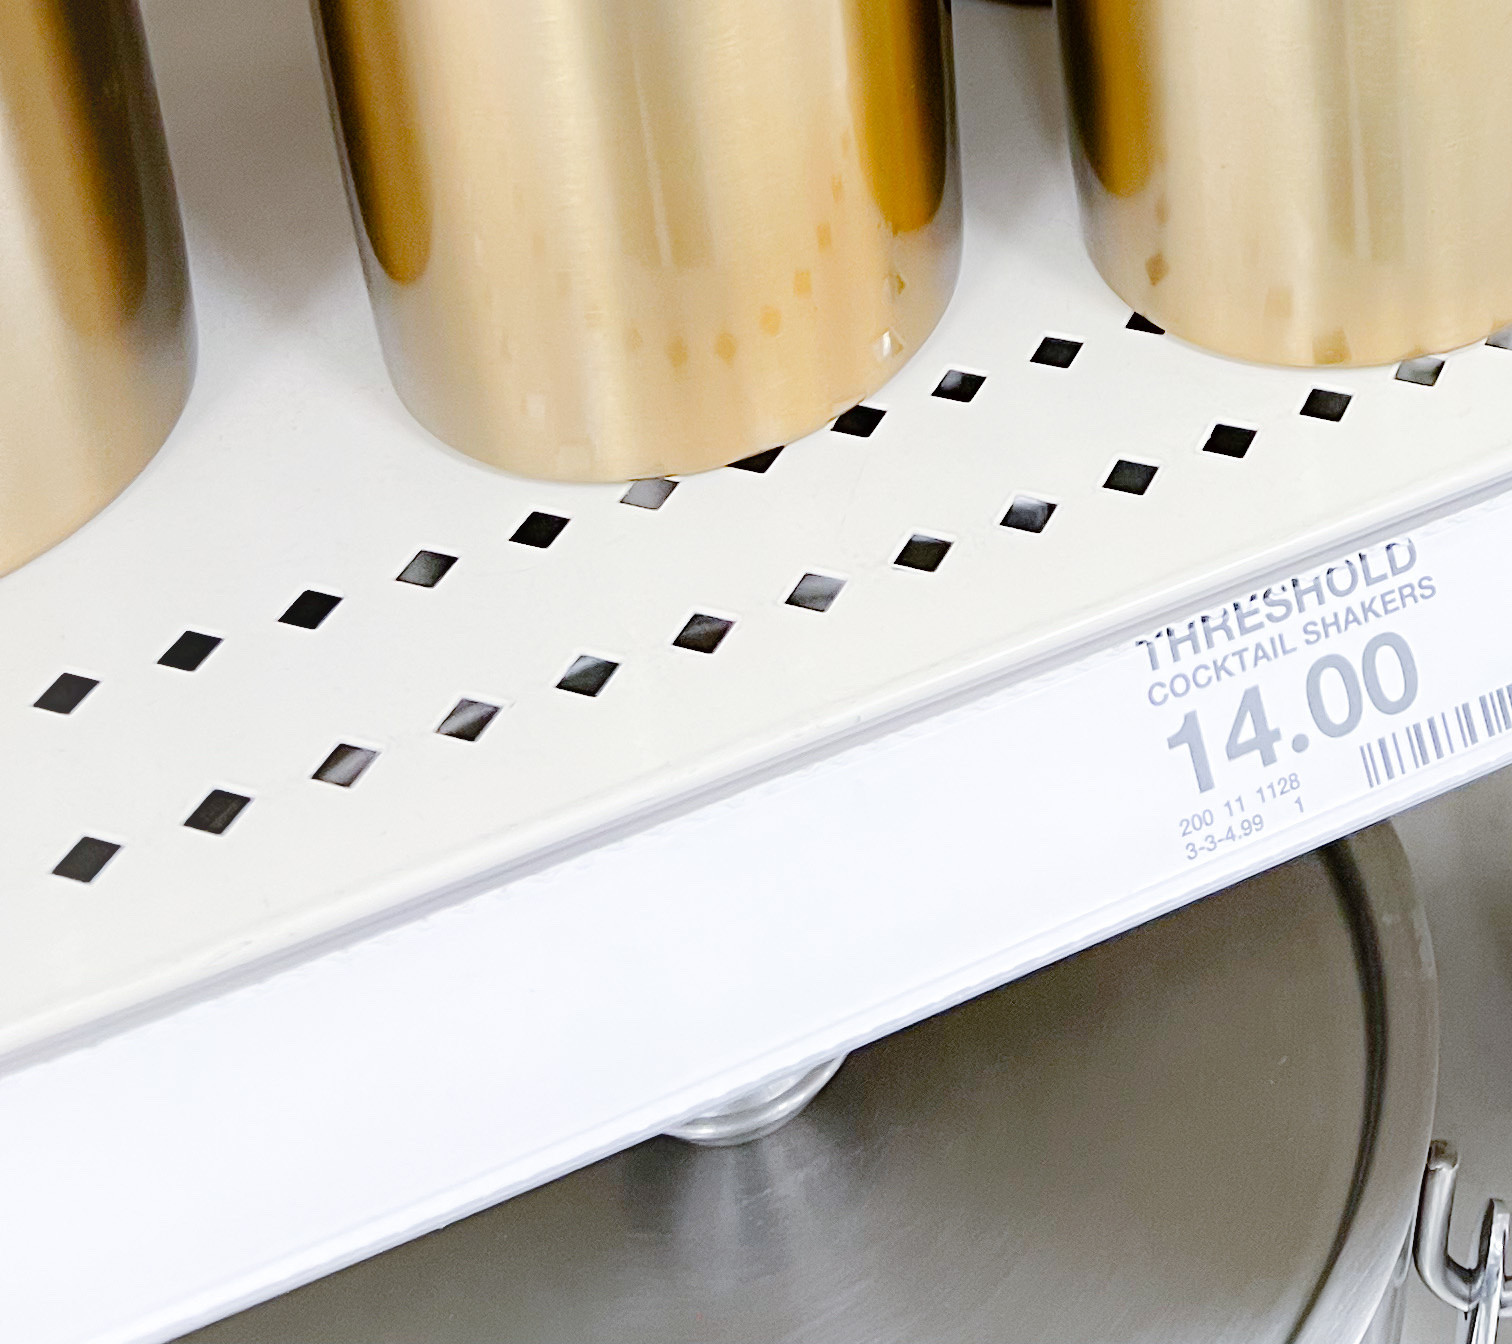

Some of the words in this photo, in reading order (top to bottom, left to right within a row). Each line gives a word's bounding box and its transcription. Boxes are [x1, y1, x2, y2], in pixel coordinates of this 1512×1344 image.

[1136, 538, 1418, 671] THRESHOLD
[1147, 633, 1298, 707] COCKTAIL
[1303, 575, 1438, 647] SHAKERS
[1167, 632, 1419, 795] 14.00
[1179, 808, 1216, 838] 200
[1223, 795, 1245, 817] 11
[1256, 772, 1301, 803] 1128
[1185, 814, 1265, 861] 3-3-4.99
[1294, 796, 1305, 813] 1
